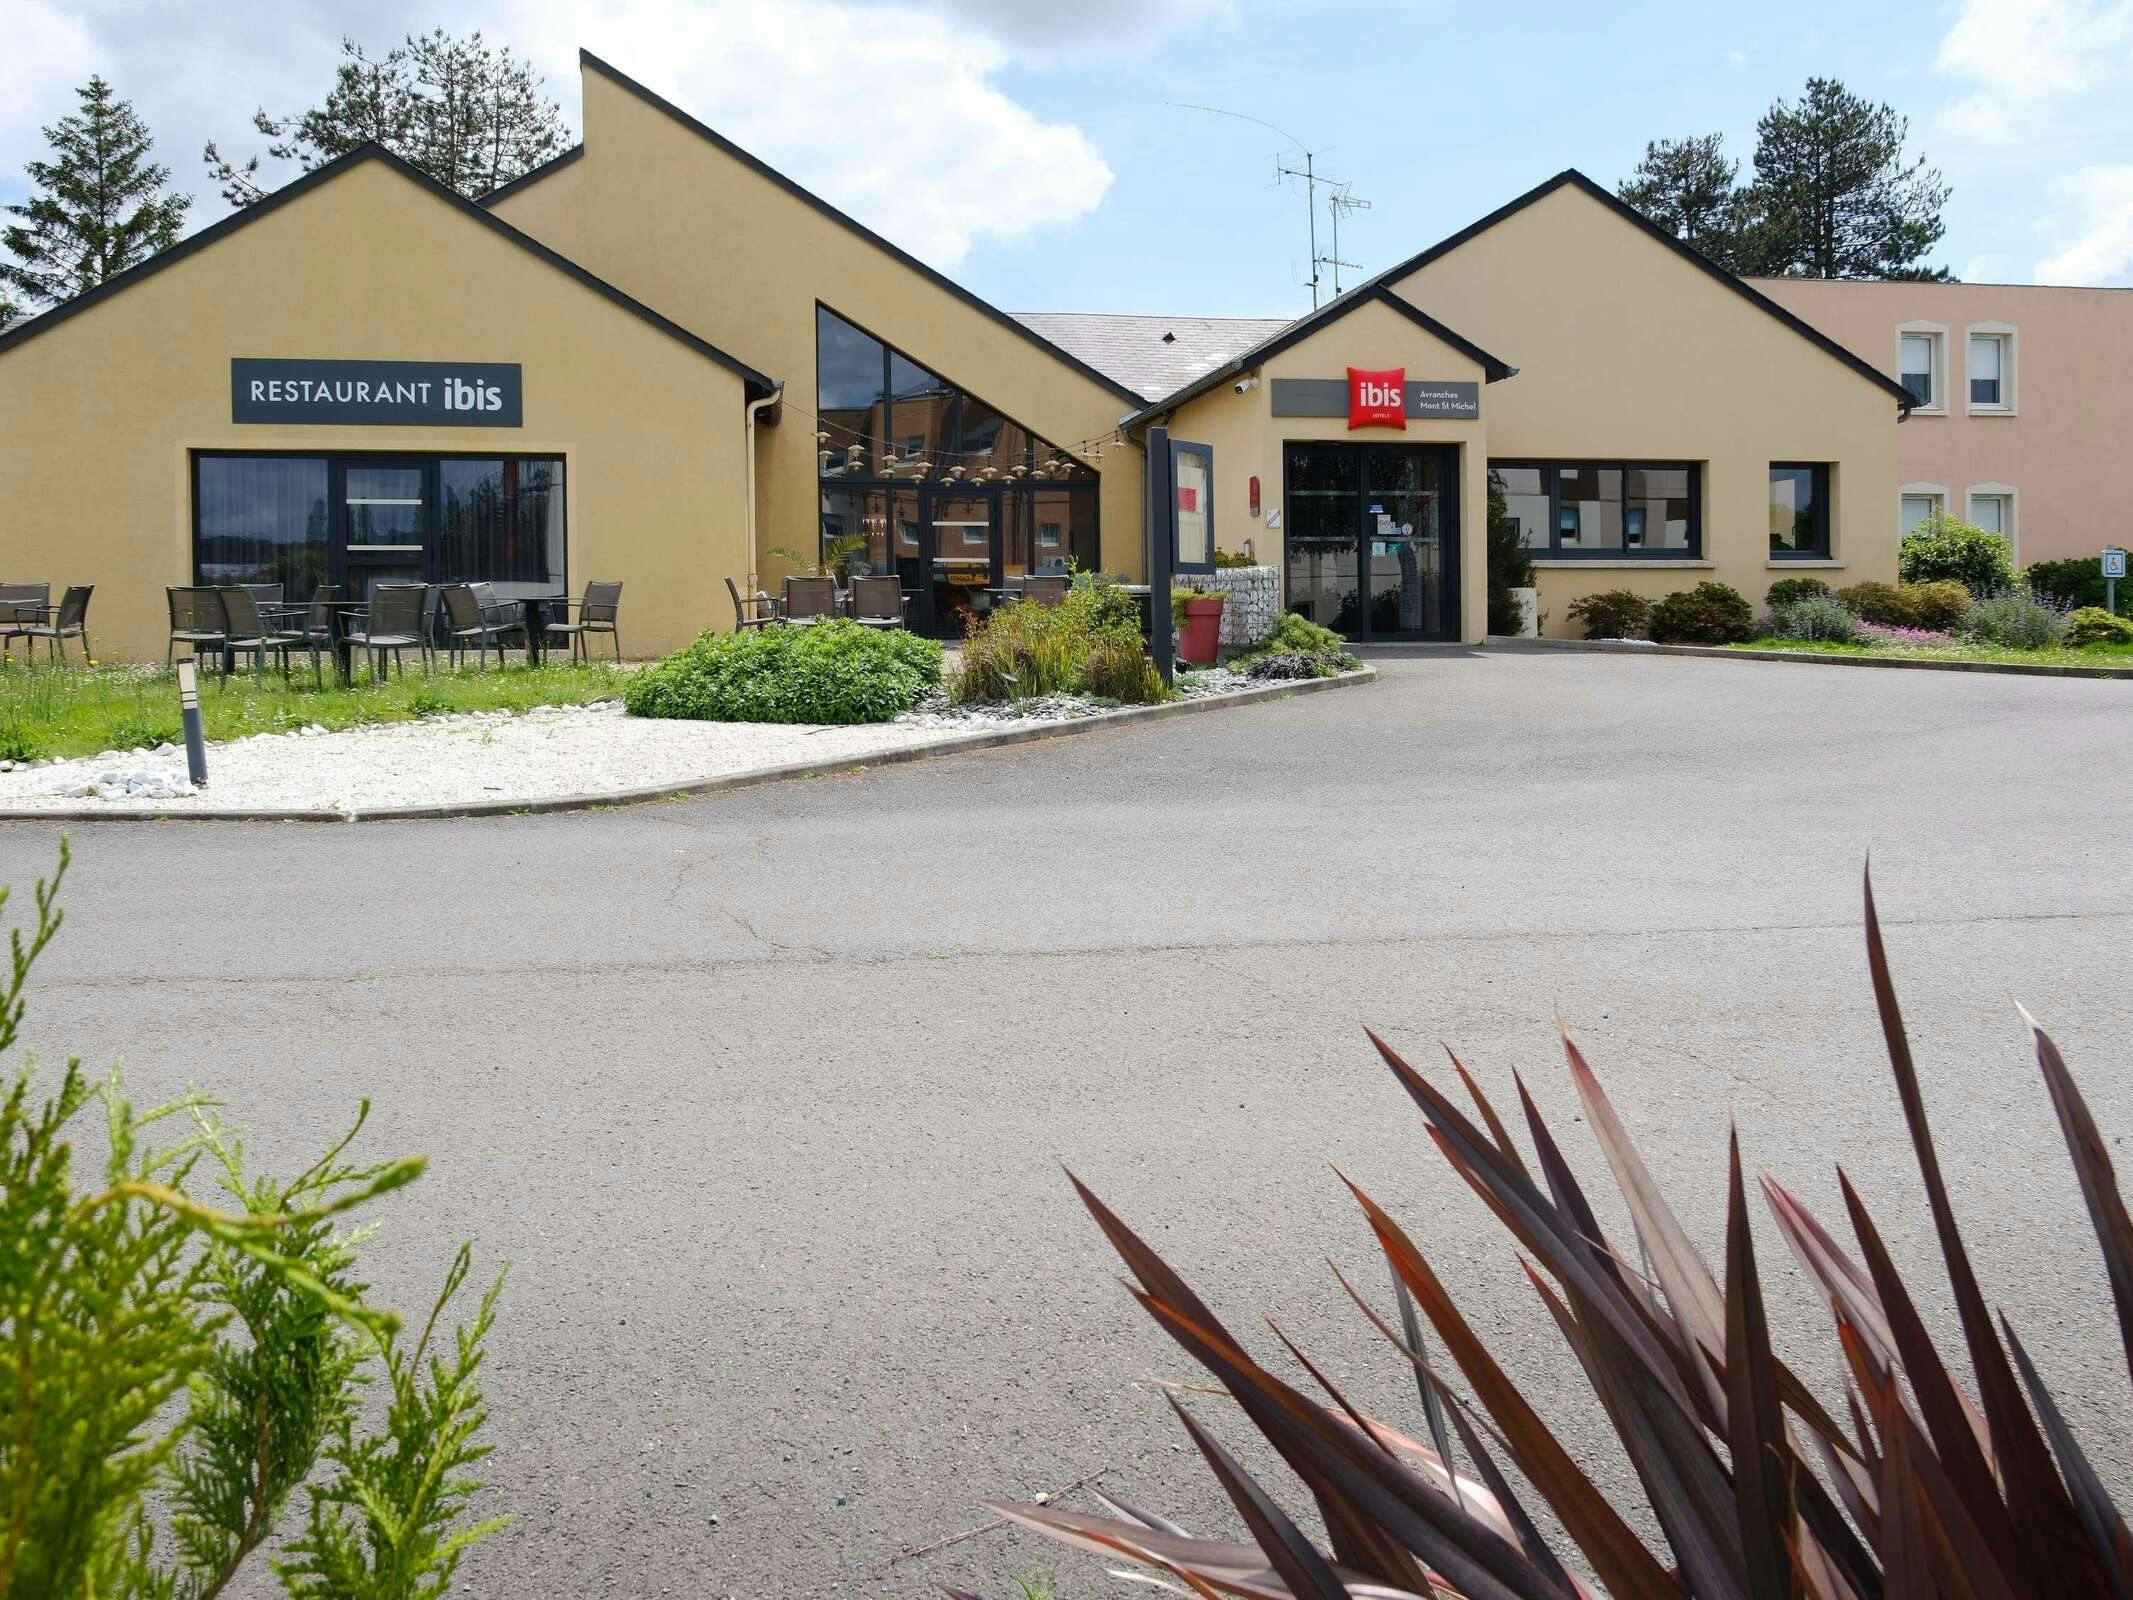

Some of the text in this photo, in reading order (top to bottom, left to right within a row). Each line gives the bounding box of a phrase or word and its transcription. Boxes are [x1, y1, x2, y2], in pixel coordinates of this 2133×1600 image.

[250, 378, 502, 411] RESTAURANT ibis
[1360, 382, 1401, 407] ibis
[1420, 391, 1458, 399] Avranches
[1441, 402, 1450, 410] St
[1451, 402, 1476, 410] Michel
